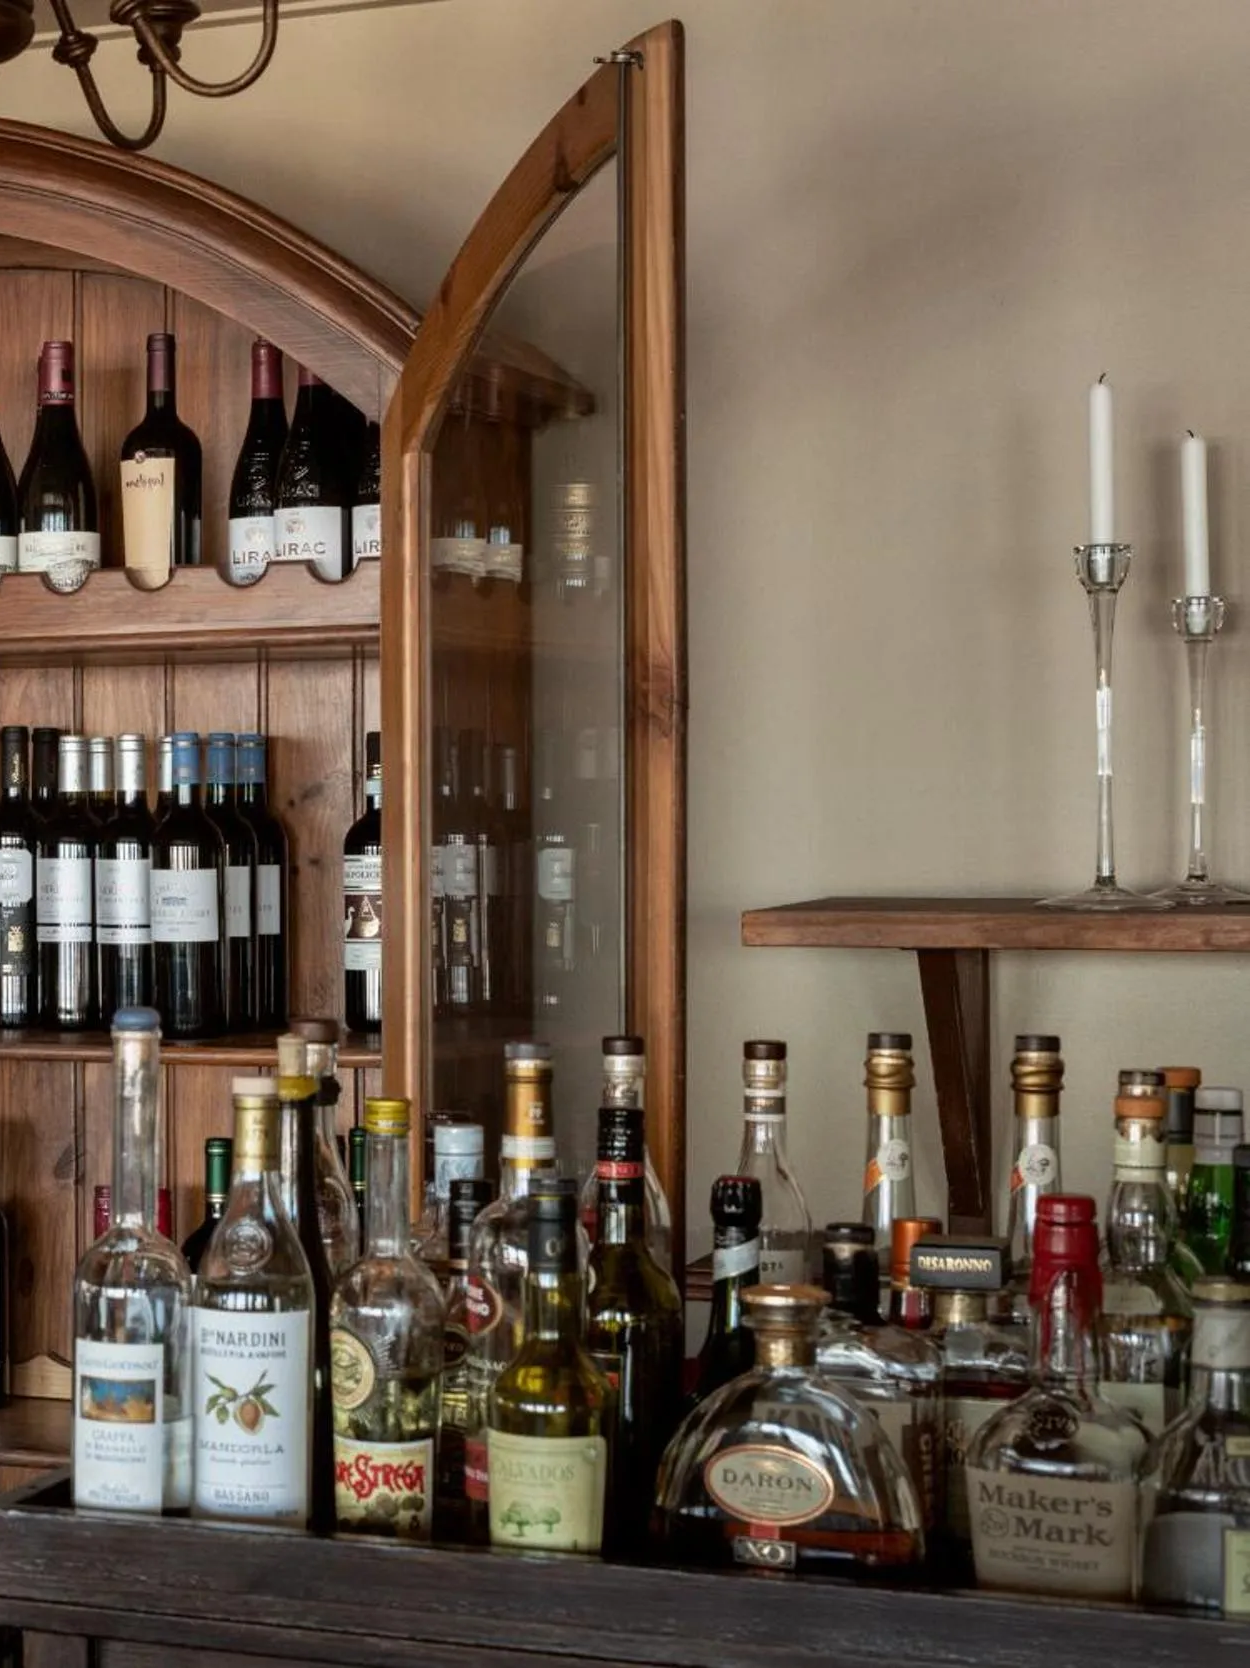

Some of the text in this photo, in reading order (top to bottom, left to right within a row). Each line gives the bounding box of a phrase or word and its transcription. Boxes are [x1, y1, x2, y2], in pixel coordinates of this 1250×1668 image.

[275, 541, 326, 558] LIRAC
[354, 539, 380, 554] LIR
[232, 551, 272, 565] LIRA
[917, 1255, 993, 1273] DISARONNO
[215, 1329, 286, 1347] NARDINI
[722, 1468, 815, 1492] DARON
[978, 1480, 1113, 1518] Maker's
[1013, 1515, 1115, 1547] Mark
[745, 1540, 787, 1563] XO
